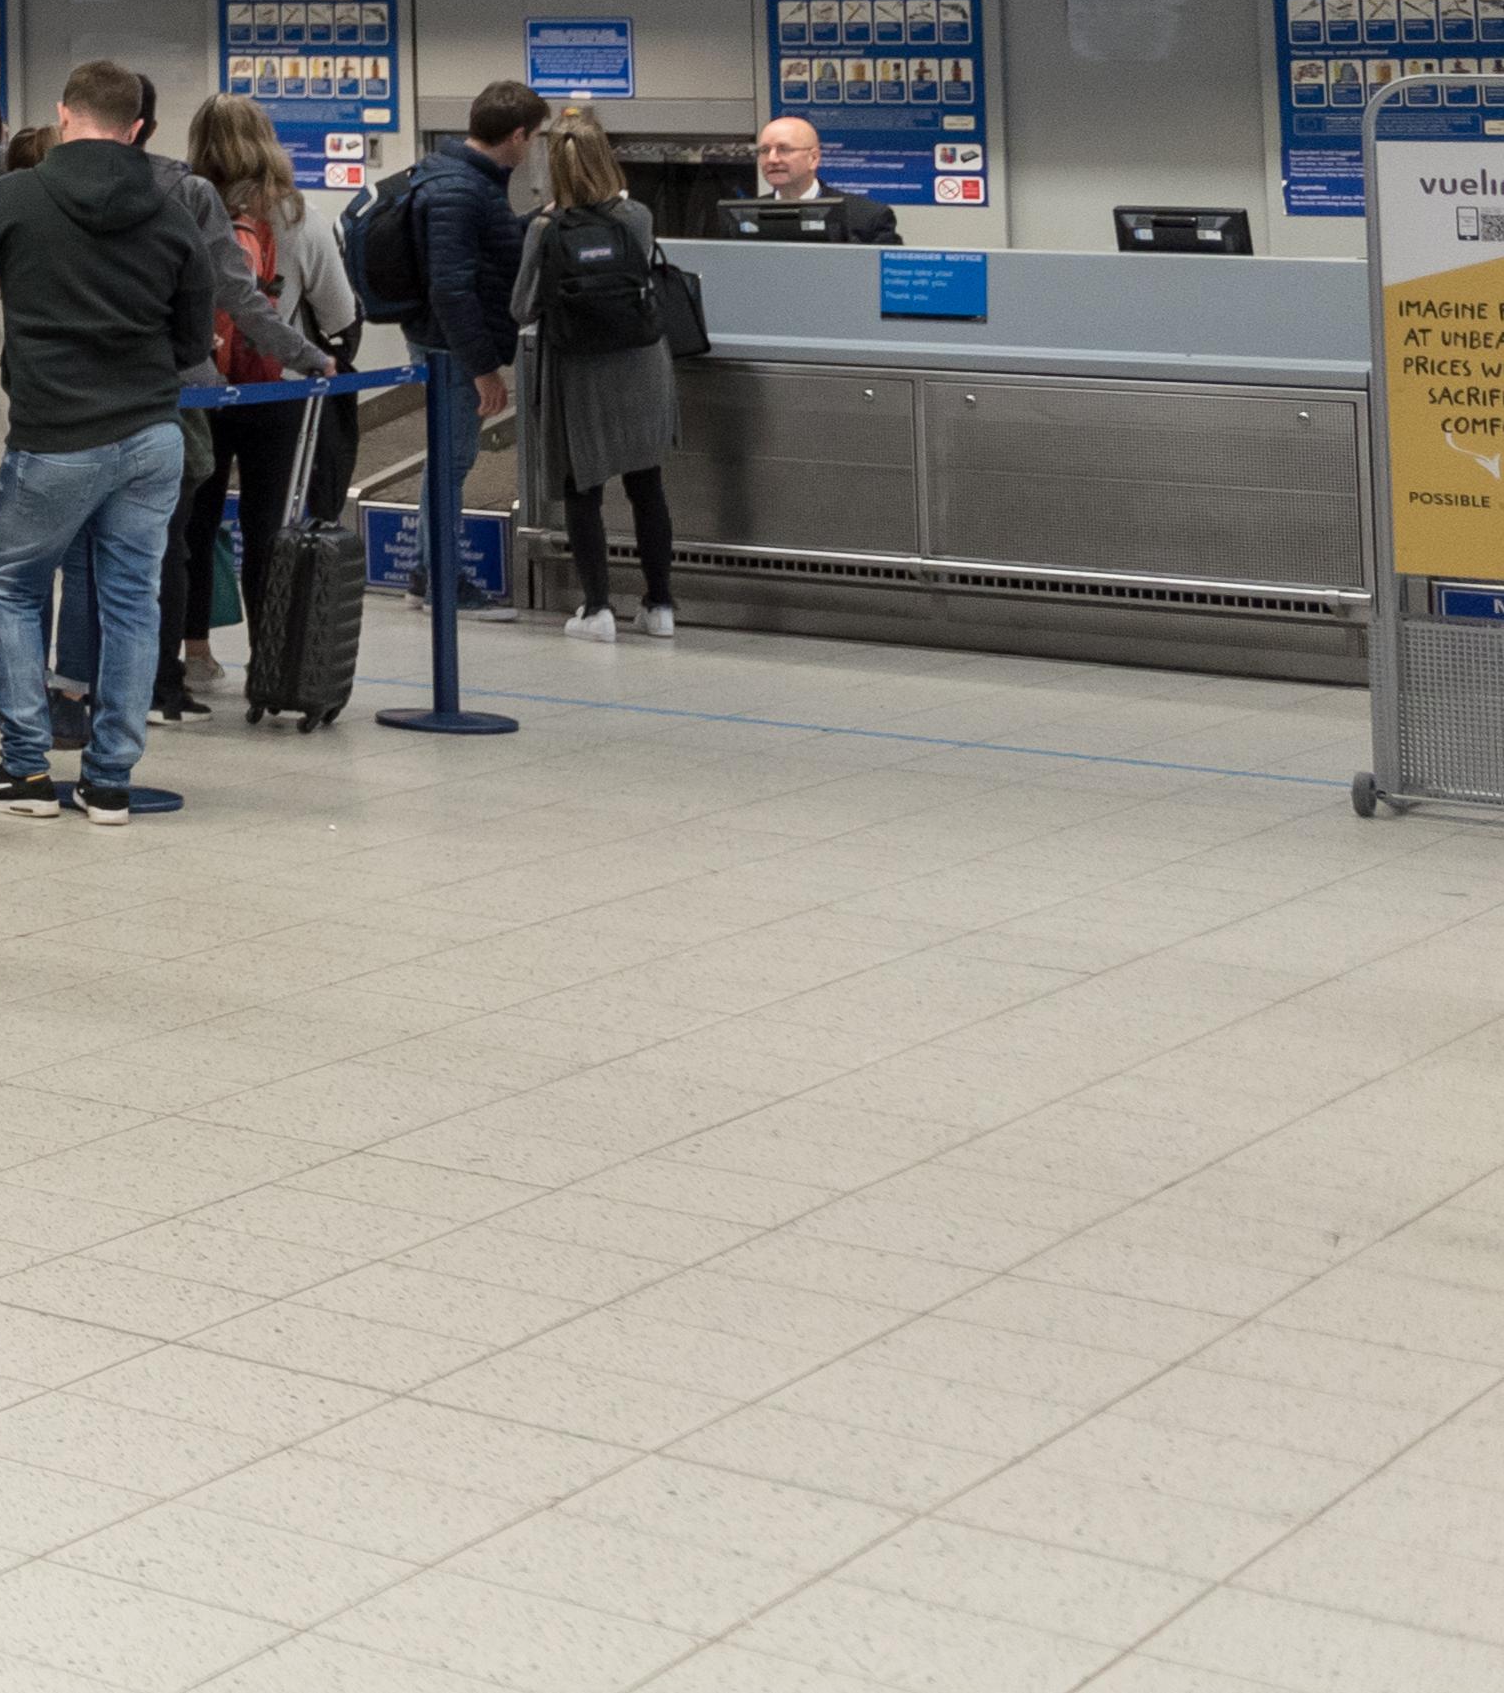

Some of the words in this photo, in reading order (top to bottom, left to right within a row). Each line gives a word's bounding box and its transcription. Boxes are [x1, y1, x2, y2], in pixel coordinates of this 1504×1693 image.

[1398, 300, 1488, 320] IMAGINE
[1403, 328, 1432, 347] AT
[1403, 355, 1472, 377] PRICES
[1409, 491, 1491, 509] POSSIBLE
